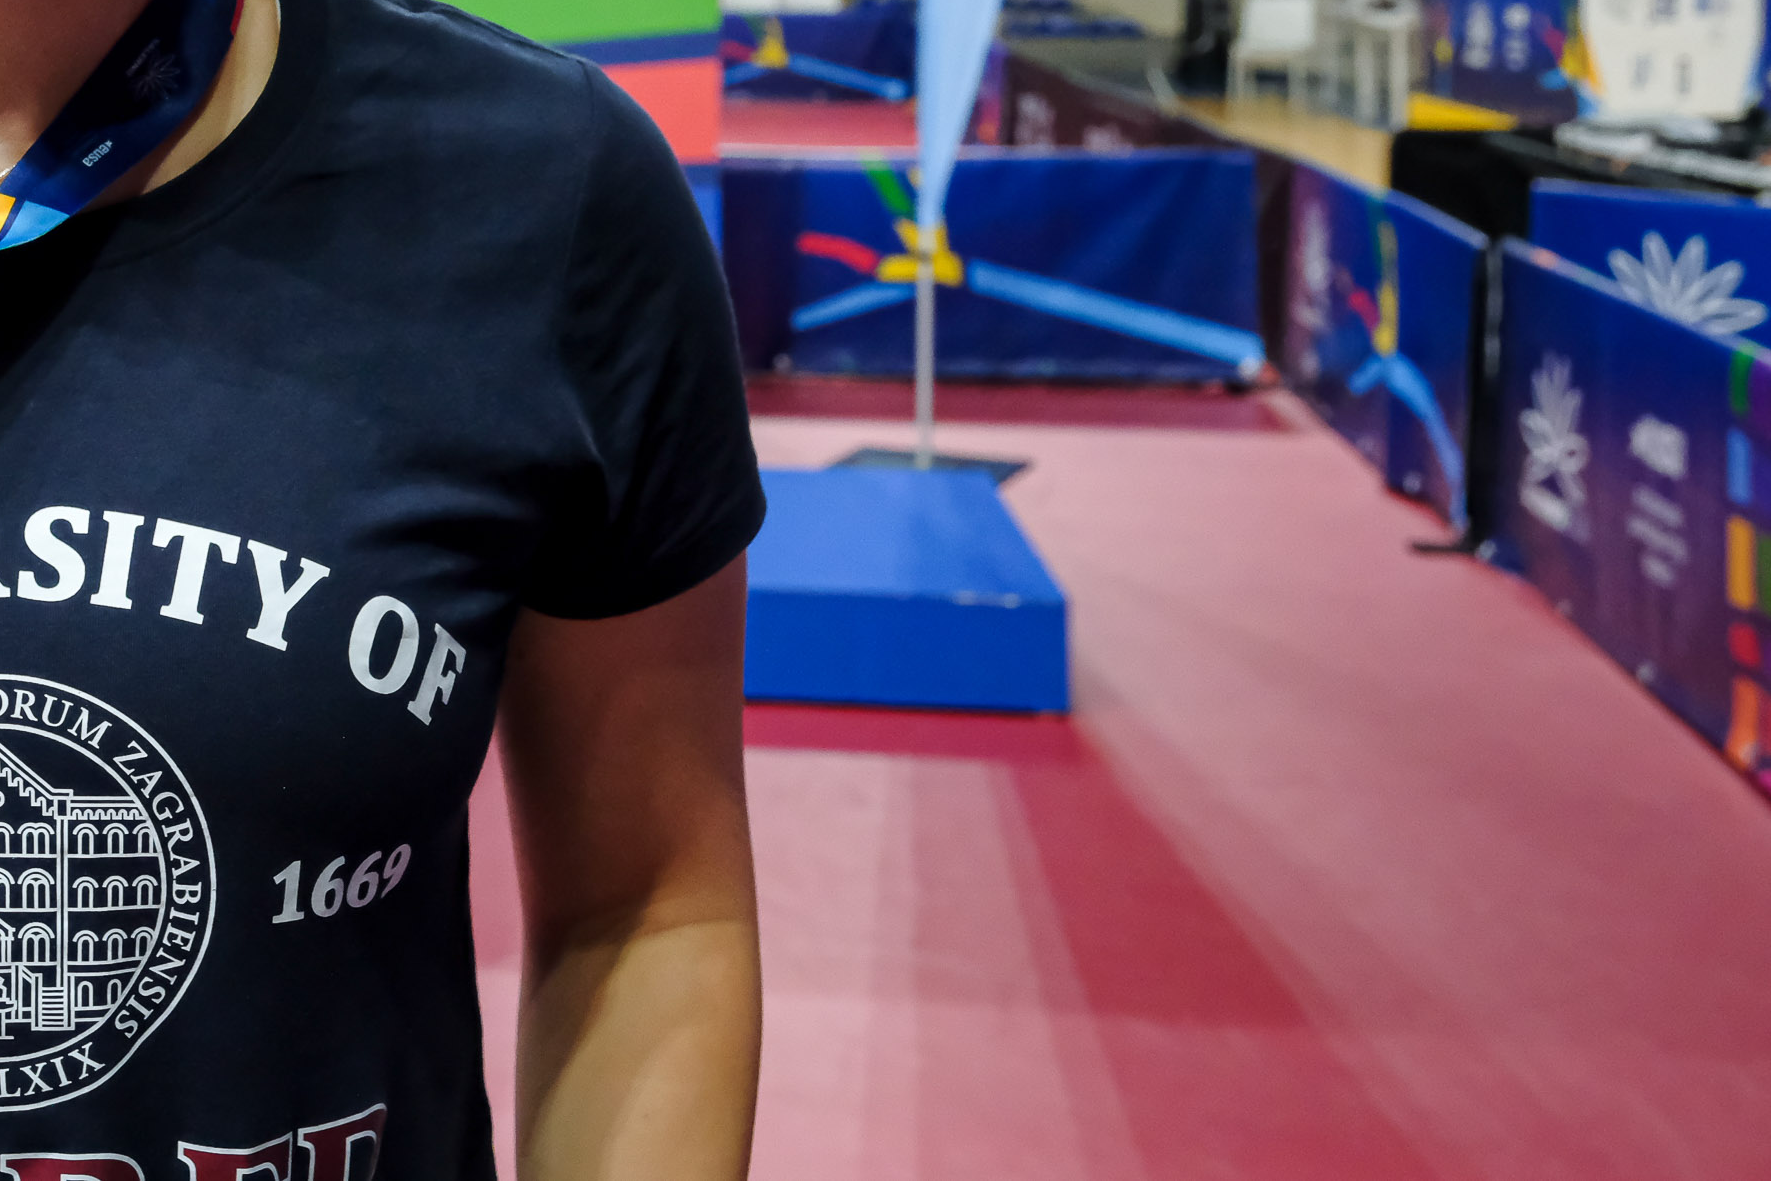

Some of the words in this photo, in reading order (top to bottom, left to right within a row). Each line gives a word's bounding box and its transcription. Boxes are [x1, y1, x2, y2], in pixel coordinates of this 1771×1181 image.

[347, 594, 467, 726] OF
[112, 740, 202, 1039] ZAGRABIENSIS
[271, 842, 412, 924] 1669
